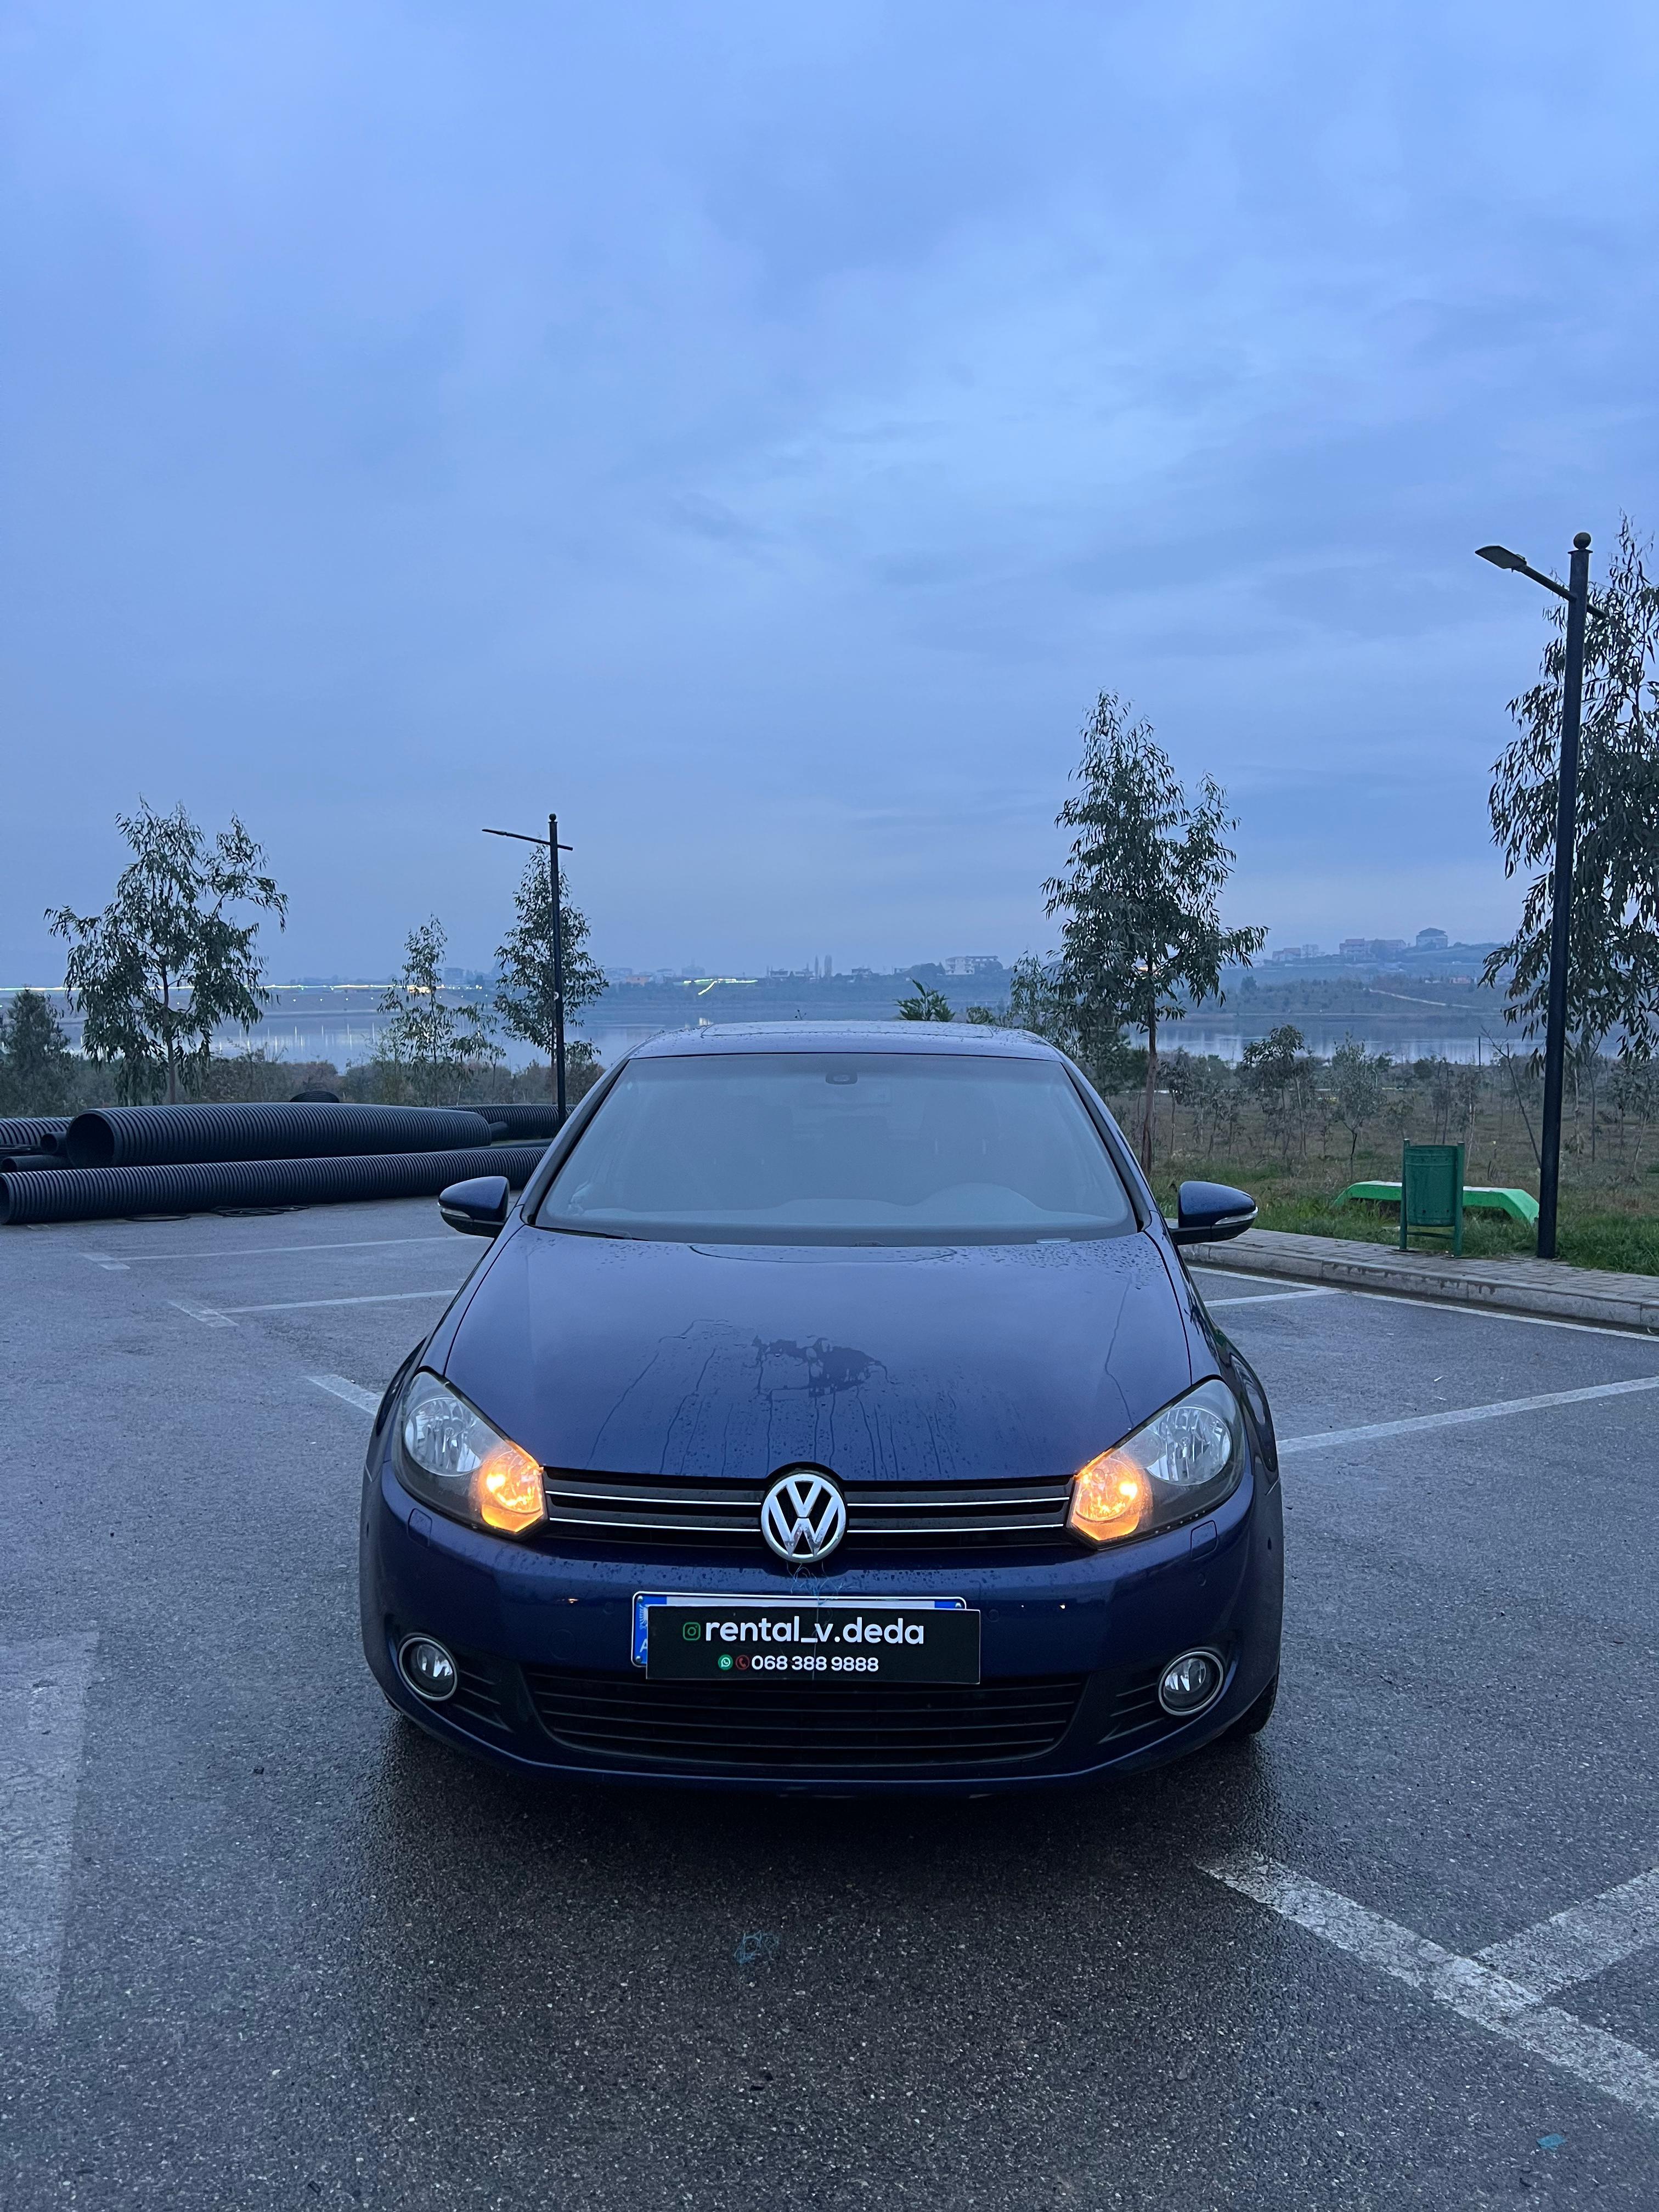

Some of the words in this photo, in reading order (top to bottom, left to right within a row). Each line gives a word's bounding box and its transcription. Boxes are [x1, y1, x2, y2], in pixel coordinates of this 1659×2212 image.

[764, 1474, 844, 1560] VW
[706, 1616, 924, 1645] rental_v.deda
[751, 1655, 788, 1671] 068
[791, 1656, 827, 1671] 388
[831, 1656, 879, 1672] 9888
